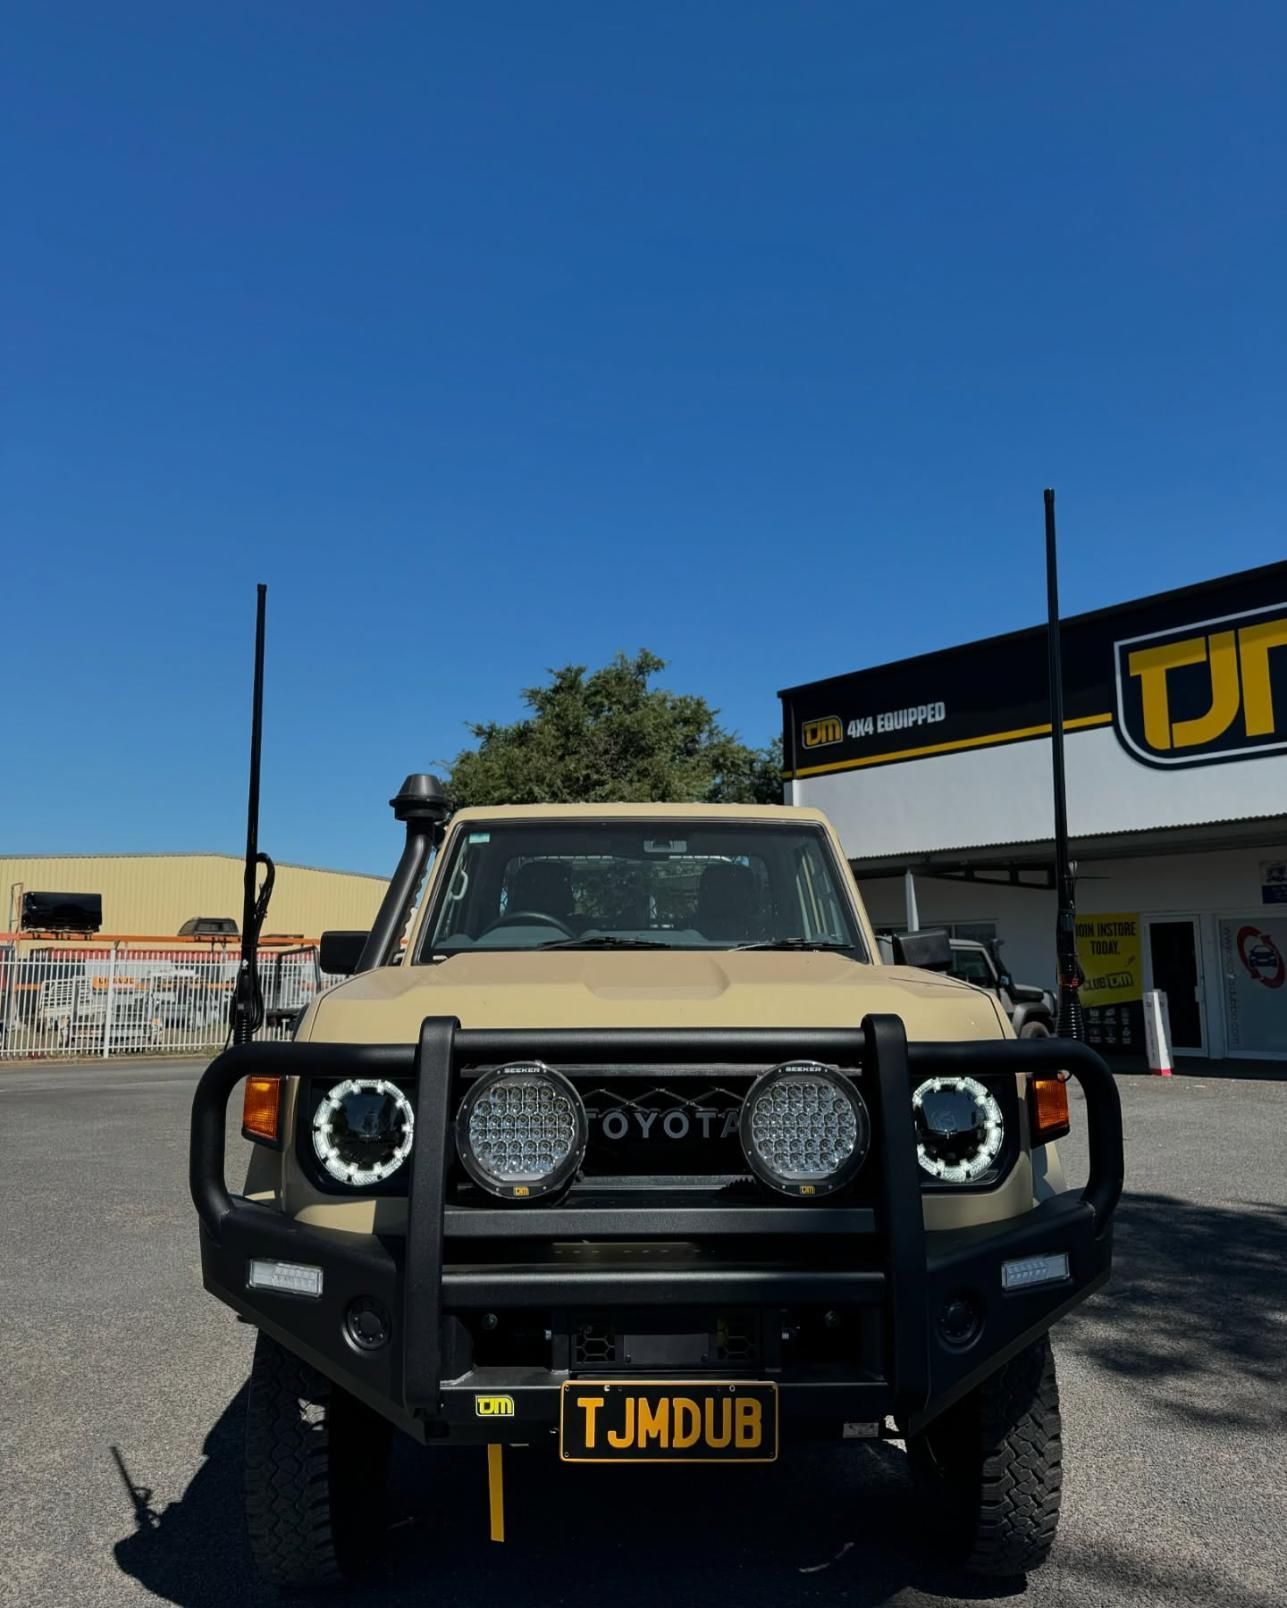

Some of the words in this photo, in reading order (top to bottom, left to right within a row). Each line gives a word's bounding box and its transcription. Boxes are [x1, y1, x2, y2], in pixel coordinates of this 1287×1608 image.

[804, 718, 841, 746] TJM
[847, 716, 874, 738] 4X4
[876, 701, 946, 734] EQUIPPED
[1097, 921, 1137, 937] INSTORE
[477, 1396, 513, 1414] TJM
[576, 1396, 763, 1449] TJMDUB
